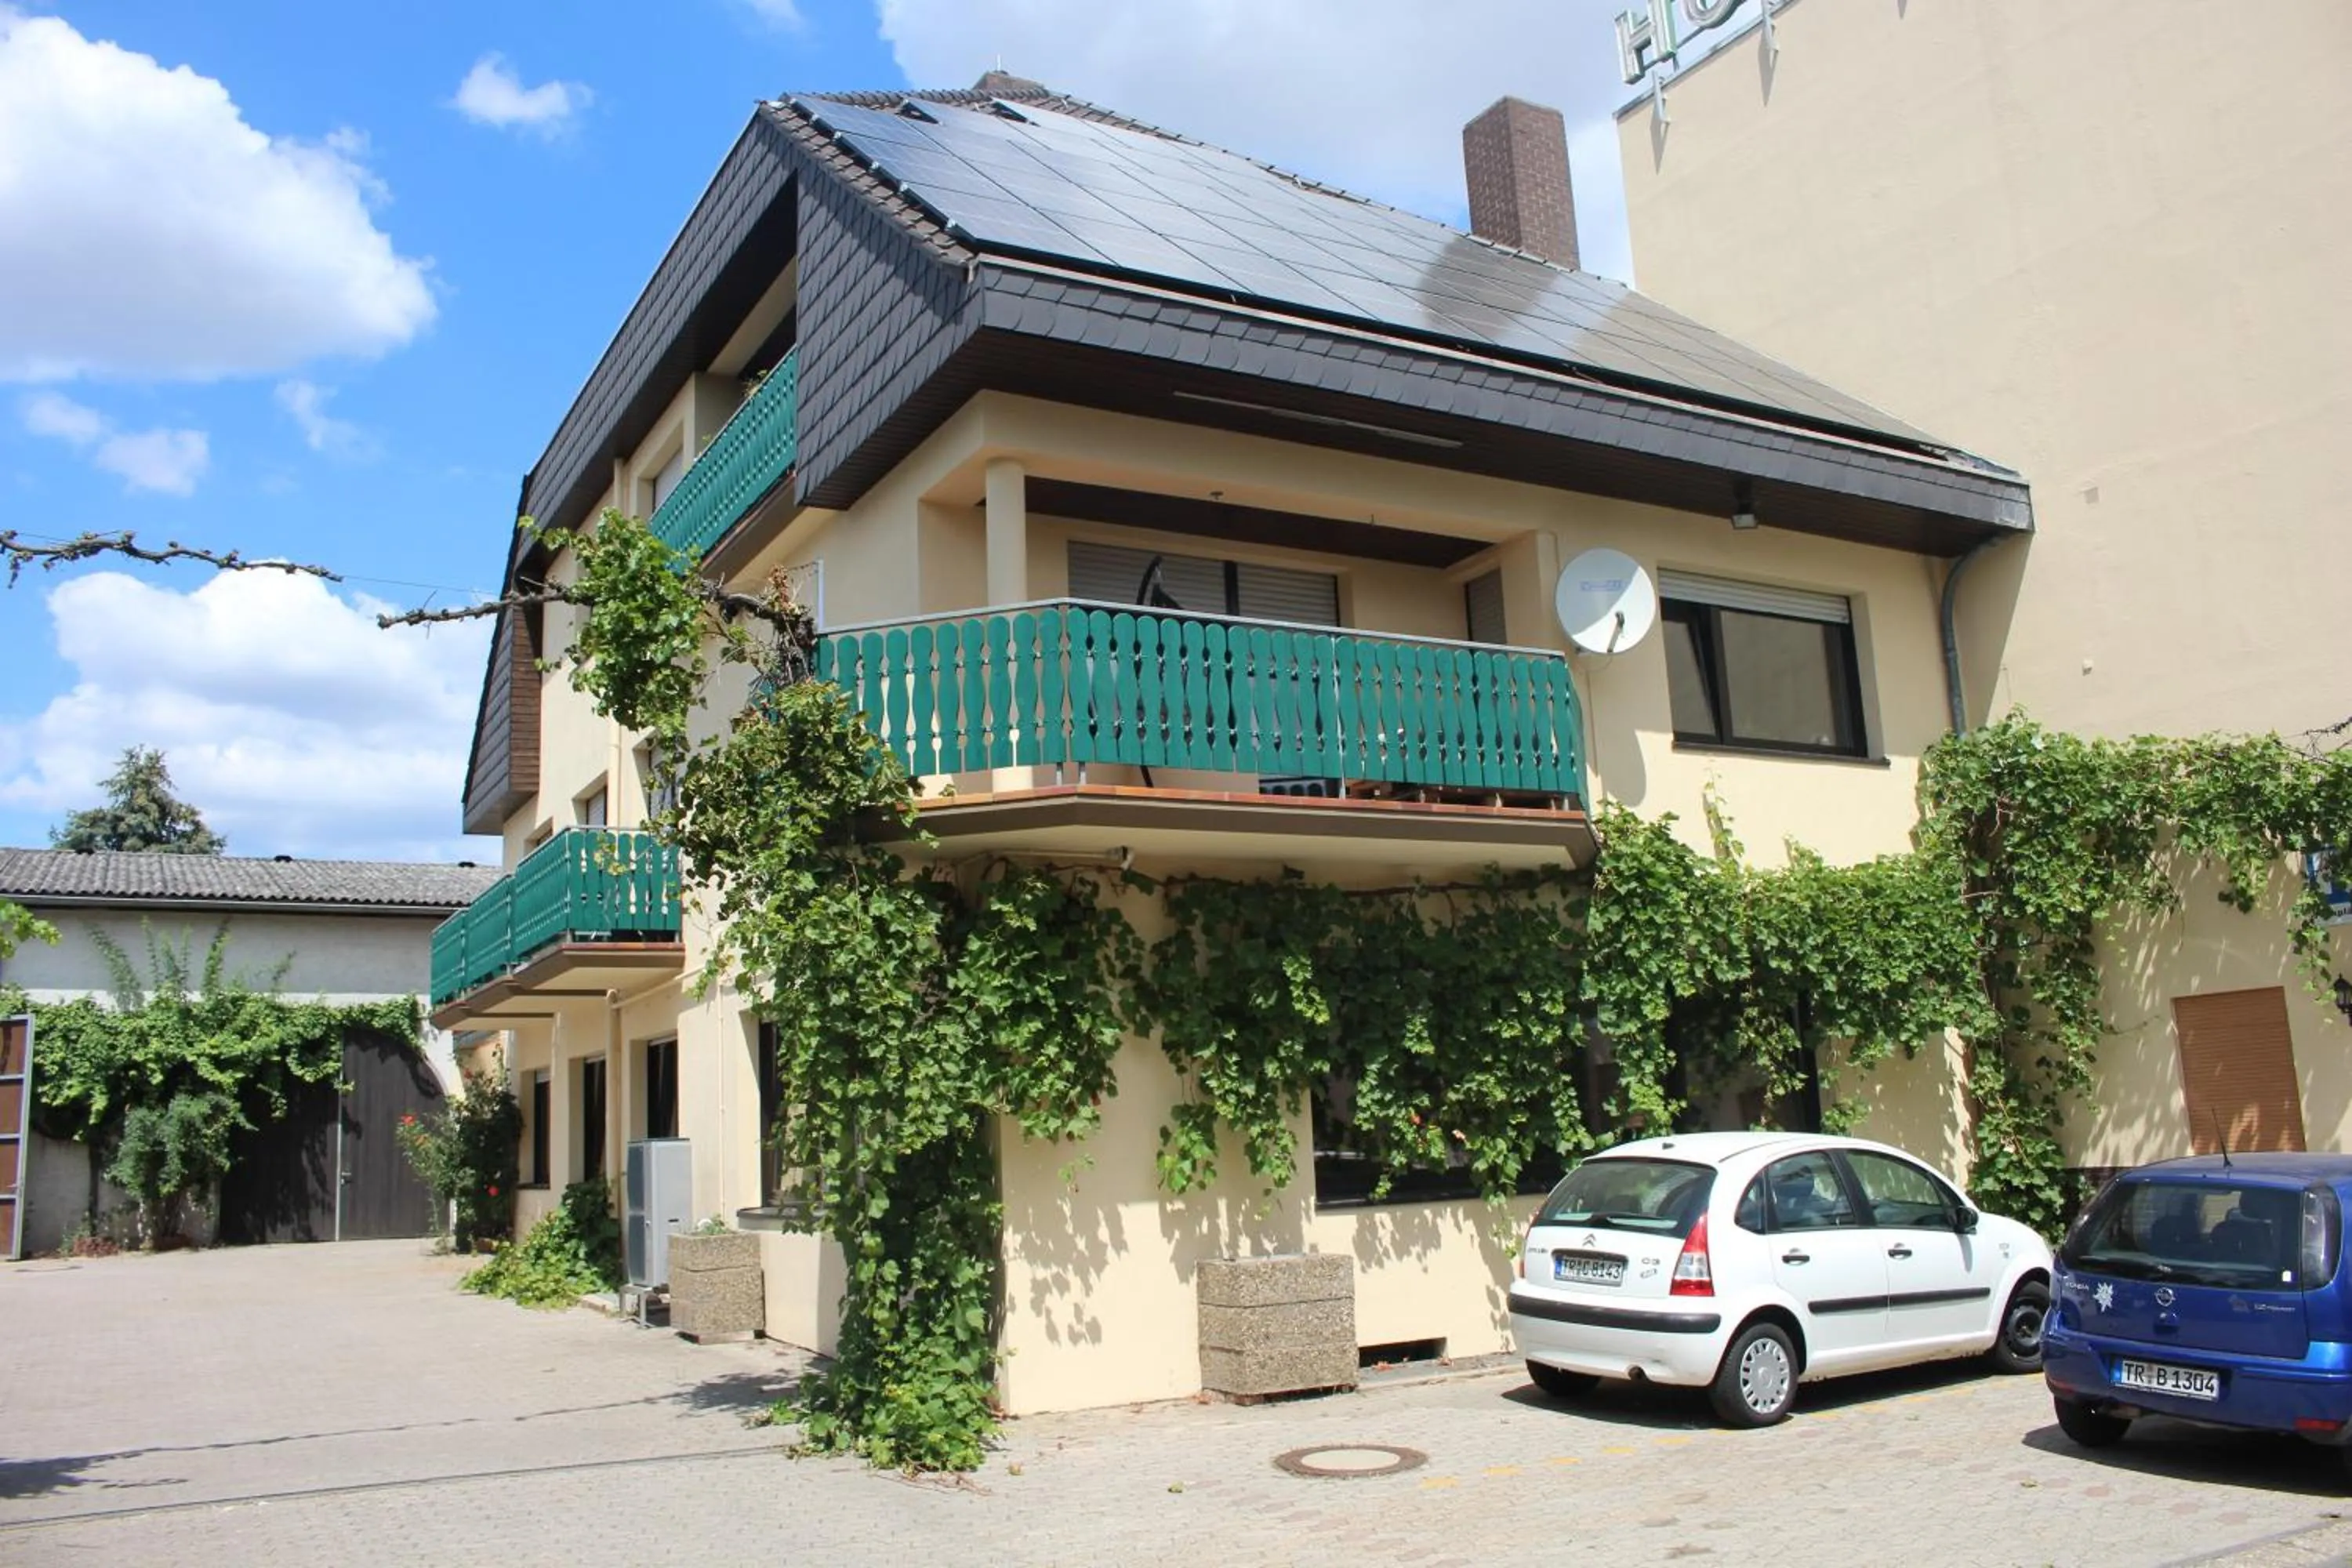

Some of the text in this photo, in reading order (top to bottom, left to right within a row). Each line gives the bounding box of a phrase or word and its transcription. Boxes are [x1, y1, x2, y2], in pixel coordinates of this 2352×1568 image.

[2124, 1363, 2215, 1393] TR B 1304
